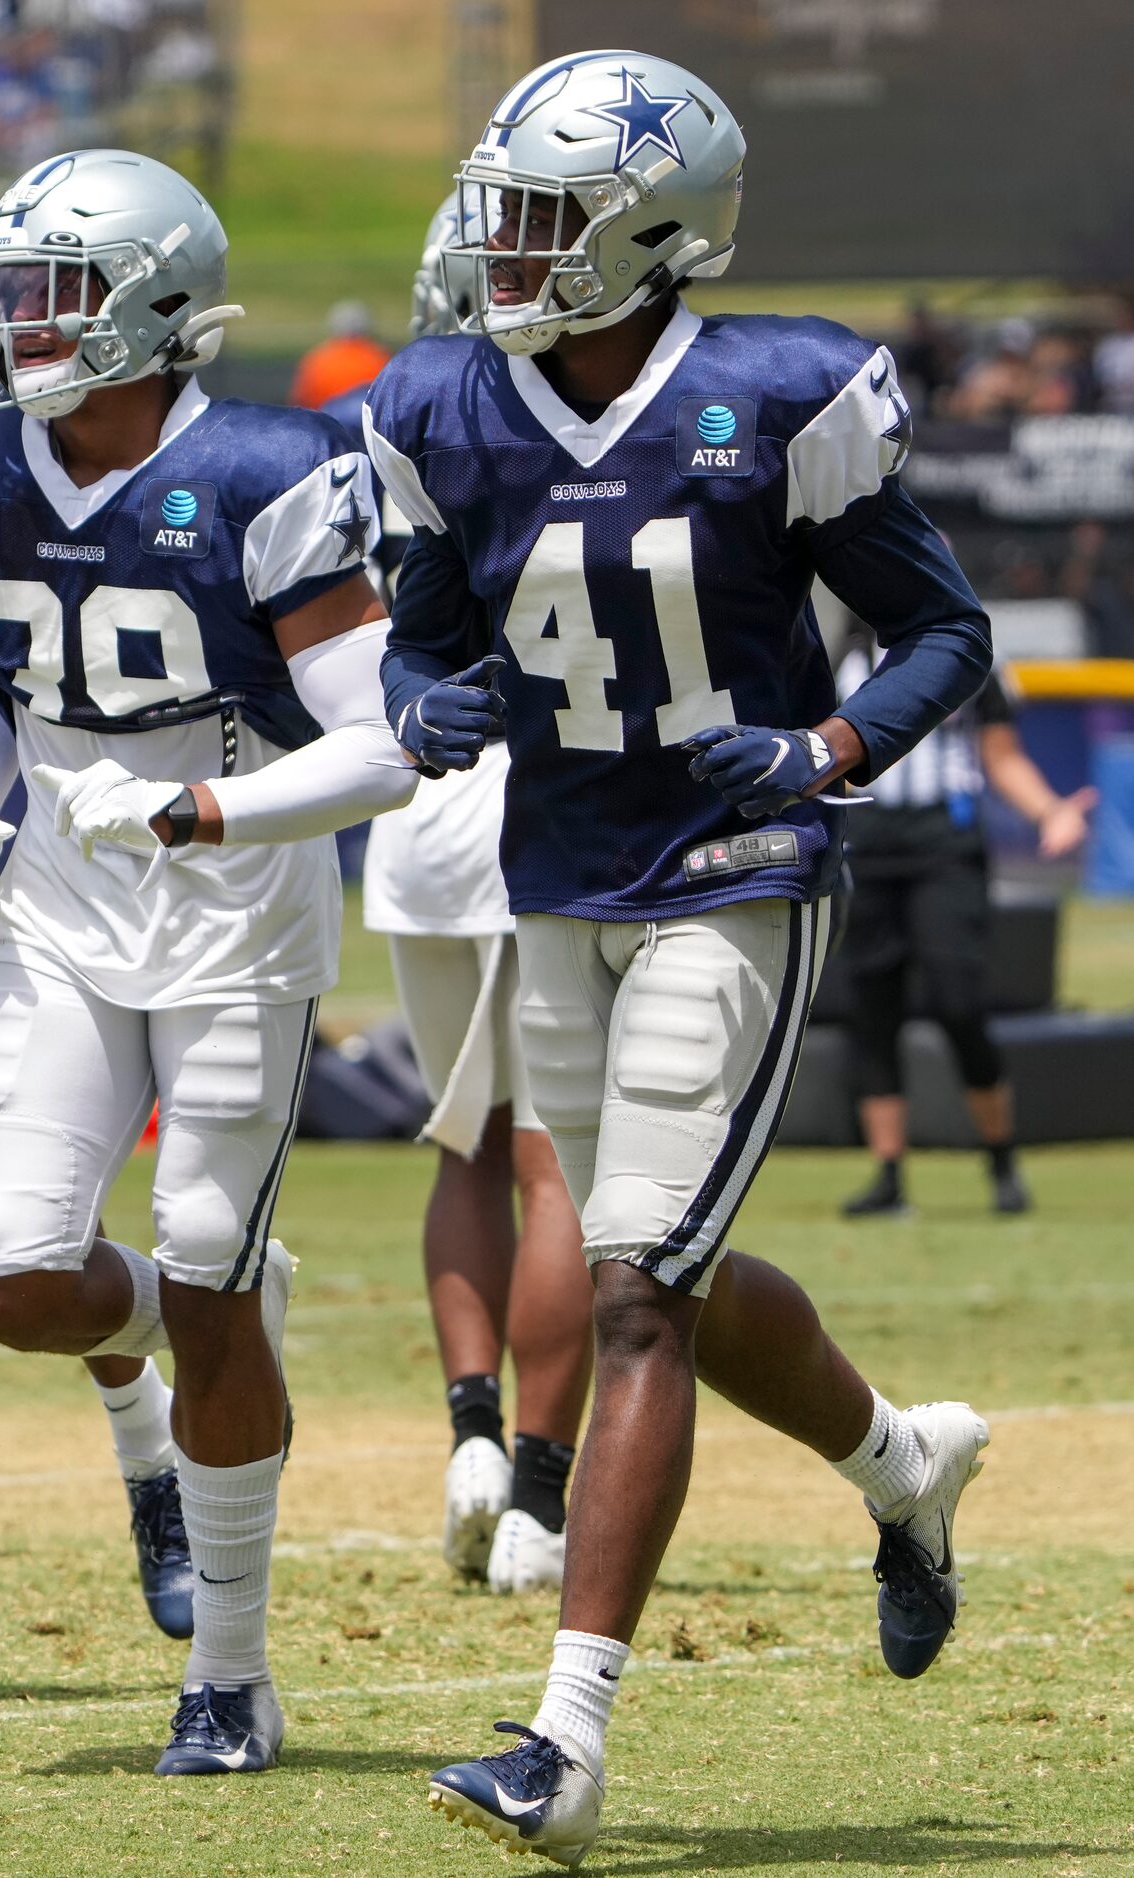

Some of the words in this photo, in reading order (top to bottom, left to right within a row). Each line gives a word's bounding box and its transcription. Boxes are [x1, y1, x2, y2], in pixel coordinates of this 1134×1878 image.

[691, 449, 740, 467] AT&T
[551, 480, 626, 500] COWBOYS
[154, 529, 197, 548] AT&T
[37, 542, 105, 561] COWBOYS
[503, 516, 736, 752] 41
